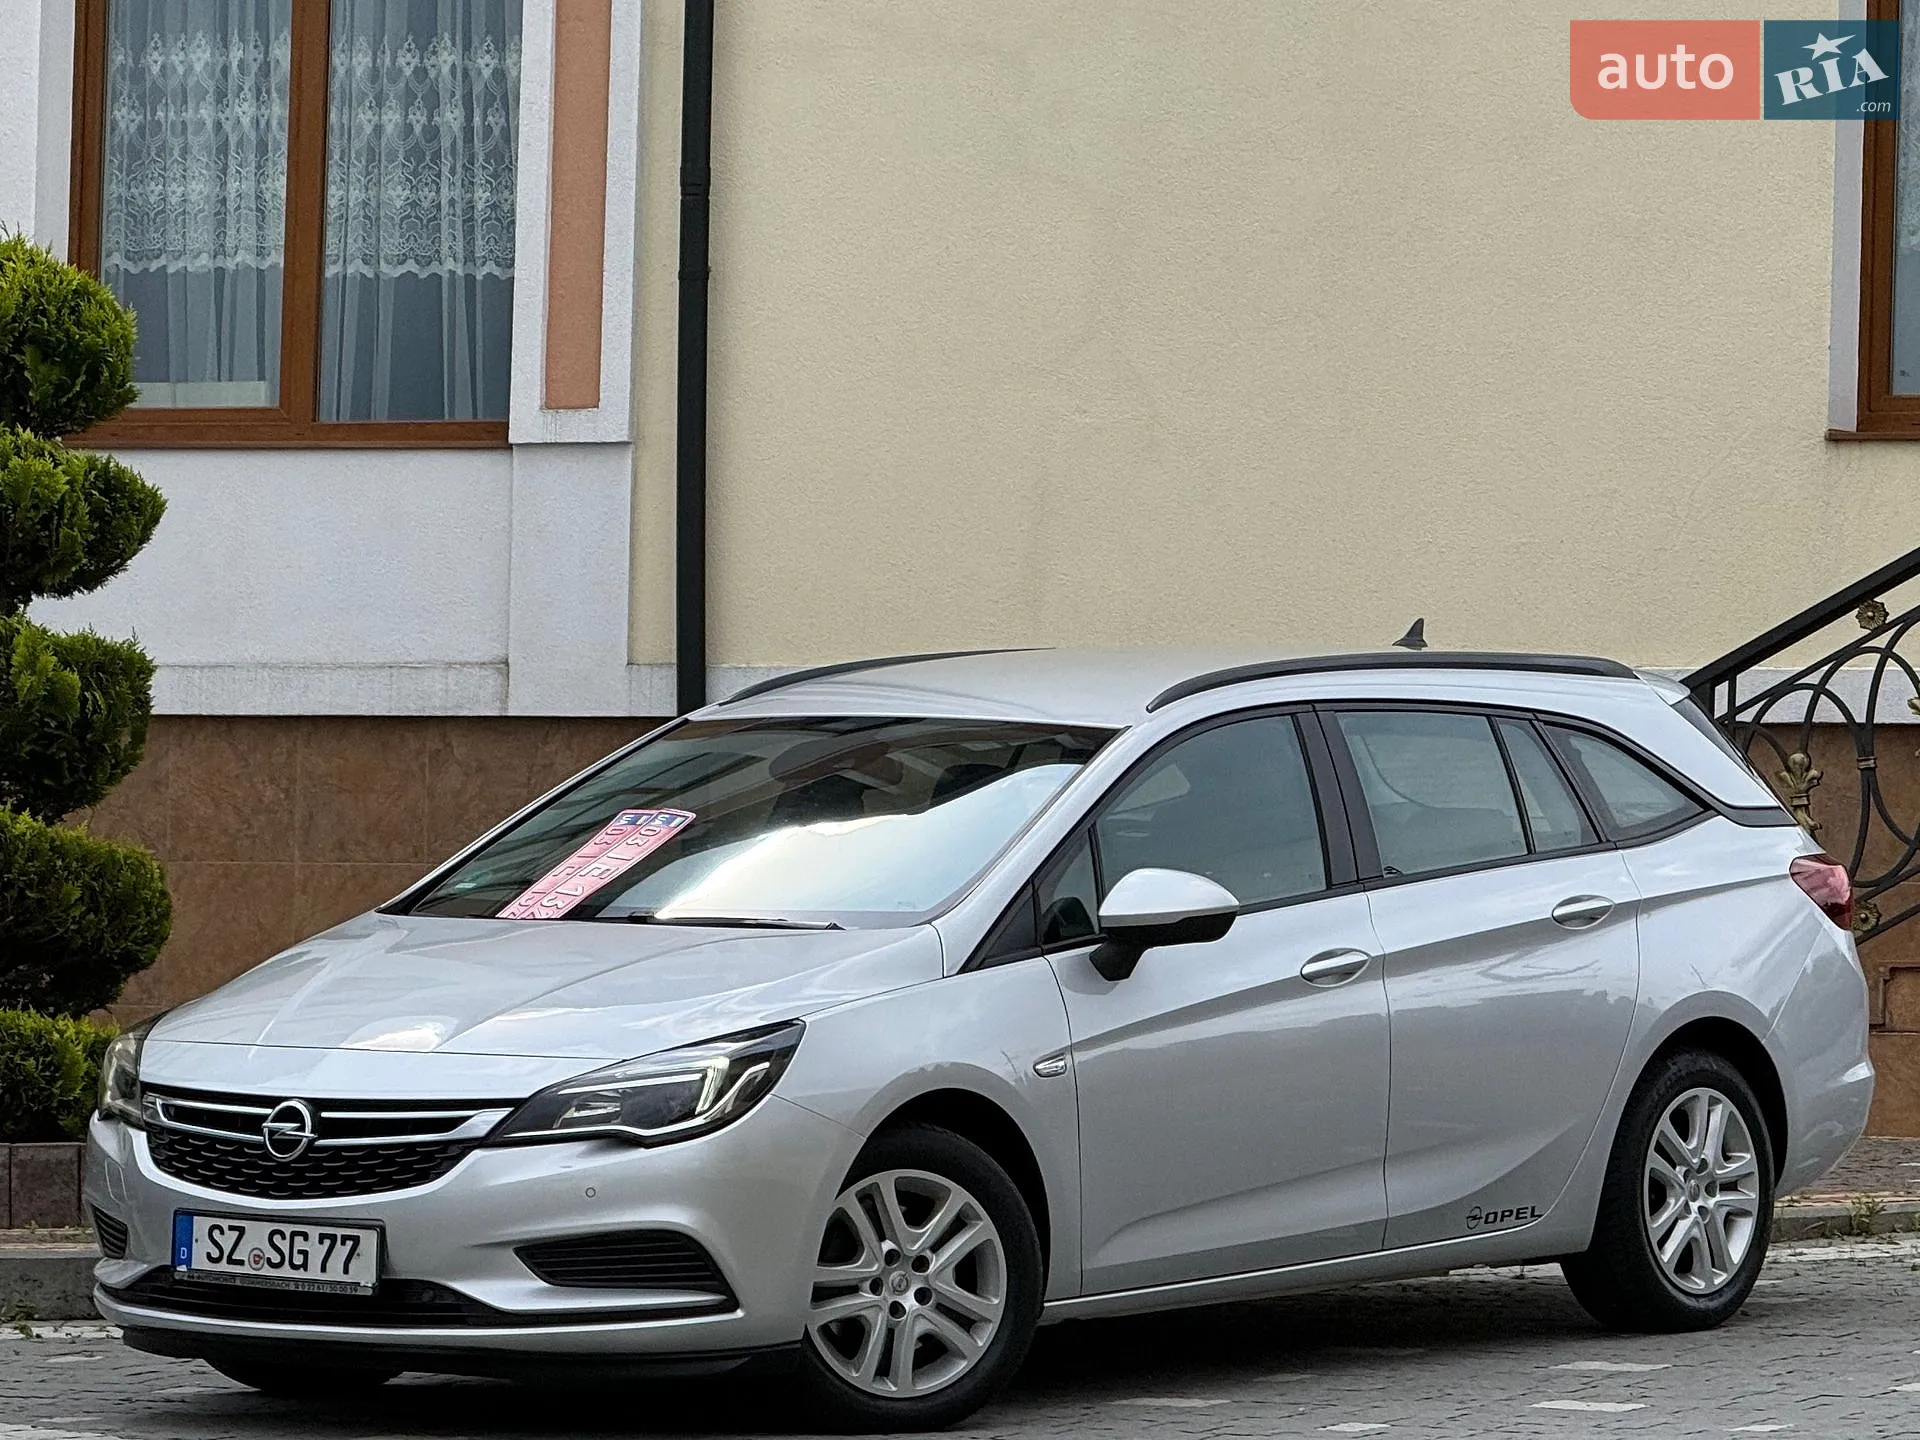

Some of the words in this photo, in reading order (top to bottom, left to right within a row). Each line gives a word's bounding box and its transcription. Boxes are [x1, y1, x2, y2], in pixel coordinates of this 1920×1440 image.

[1484, 1205, 1543, 1225] OPEL
[180, 1247, 188, 1259] D
[206, 1224, 245, 1266] SZ
[266, 1228, 309, 1272] SG
[318, 1232, 360, 1275] 77
